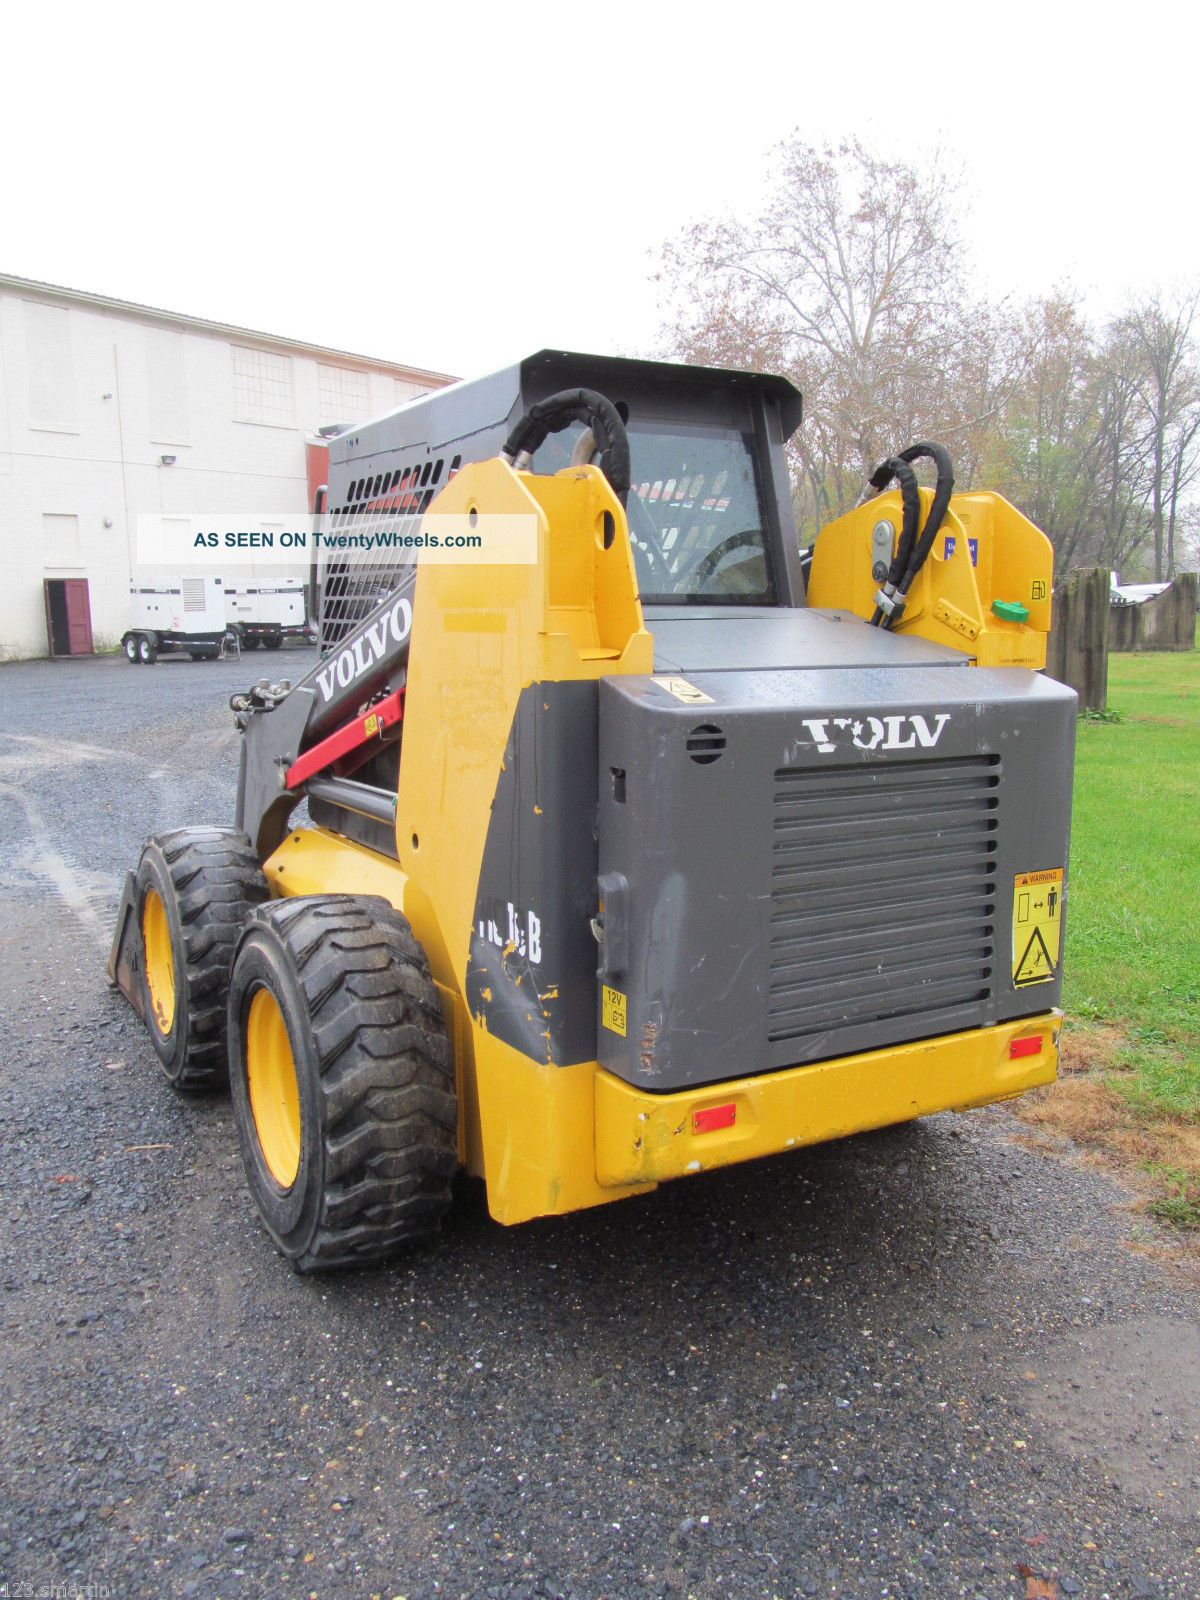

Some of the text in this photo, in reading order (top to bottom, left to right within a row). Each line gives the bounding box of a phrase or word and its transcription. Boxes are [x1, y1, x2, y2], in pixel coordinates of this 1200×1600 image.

[316, 598, 413, 702] VOLVO
[1029, 872, 1057, 882] WARNING
[608, 990, 622, 1006] 12V
